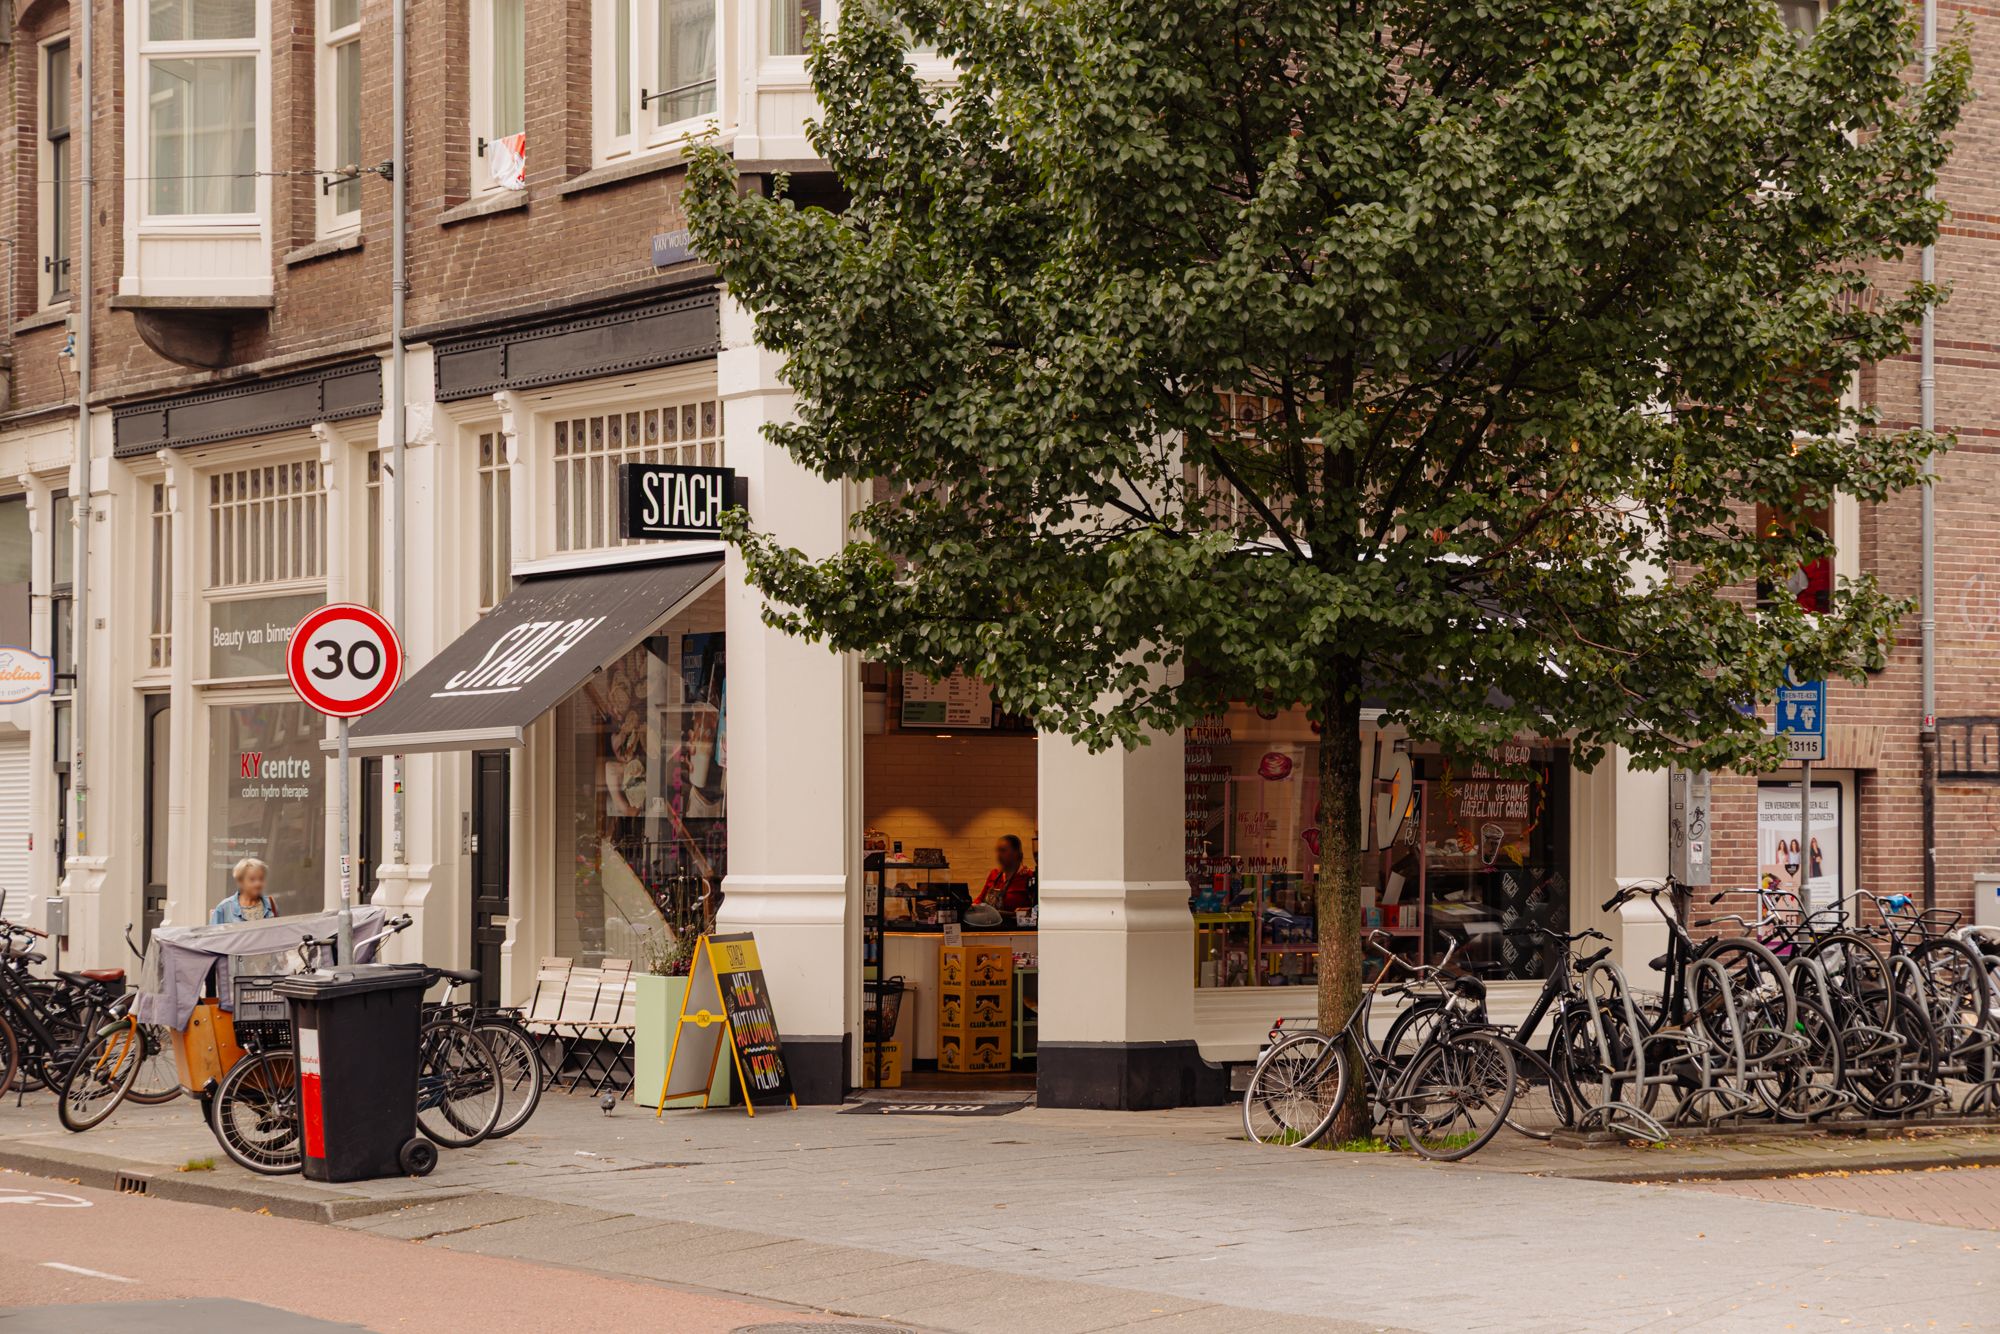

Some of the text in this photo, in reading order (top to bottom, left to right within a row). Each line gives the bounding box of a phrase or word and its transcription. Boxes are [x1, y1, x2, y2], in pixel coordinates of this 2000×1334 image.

[655, 232, 690, 252] VAN WOUST
[642, 471, 723, 527] STACH
[213, 627, 245, 651] Beauty
[246, 630, 263, 644] van
[311, 639, 381, 680] 30
[444, 615, 607, 691] STACH
[240, 751, 311, 779] KYcentre
[1505, 746, 1530, 763] BREAD
[241, 784, 309, 801] colon hydro therapie
[1464, 784, 1530, 801] BLACK SESAME
[1460, 801, 1528, 818] HAZELNUT CACAO
[1764, 801, 1773, 810] EEN
[1818, 801, 1829, 809] ALLE
[1502, 872, 1520, 898] STACH
[1526, 886, 1544, 911] STACH
[727, 944, 745, 967] STACH
[1502, 938, 1519, 965] STACH
[731, 972, 756, 1008] NEW
[970, 979, 1007, 987] CLUB-MATE
[732, 1008, 775, 1048] AUTUMN
[970, 1020, 1007, 1029] CLUB-MATE
[751, 1053, 780, 1091] MENU
[969, 1062, 1006, 1070] CLUB-MATE
[879, 1104, 985, 1112] STACH
